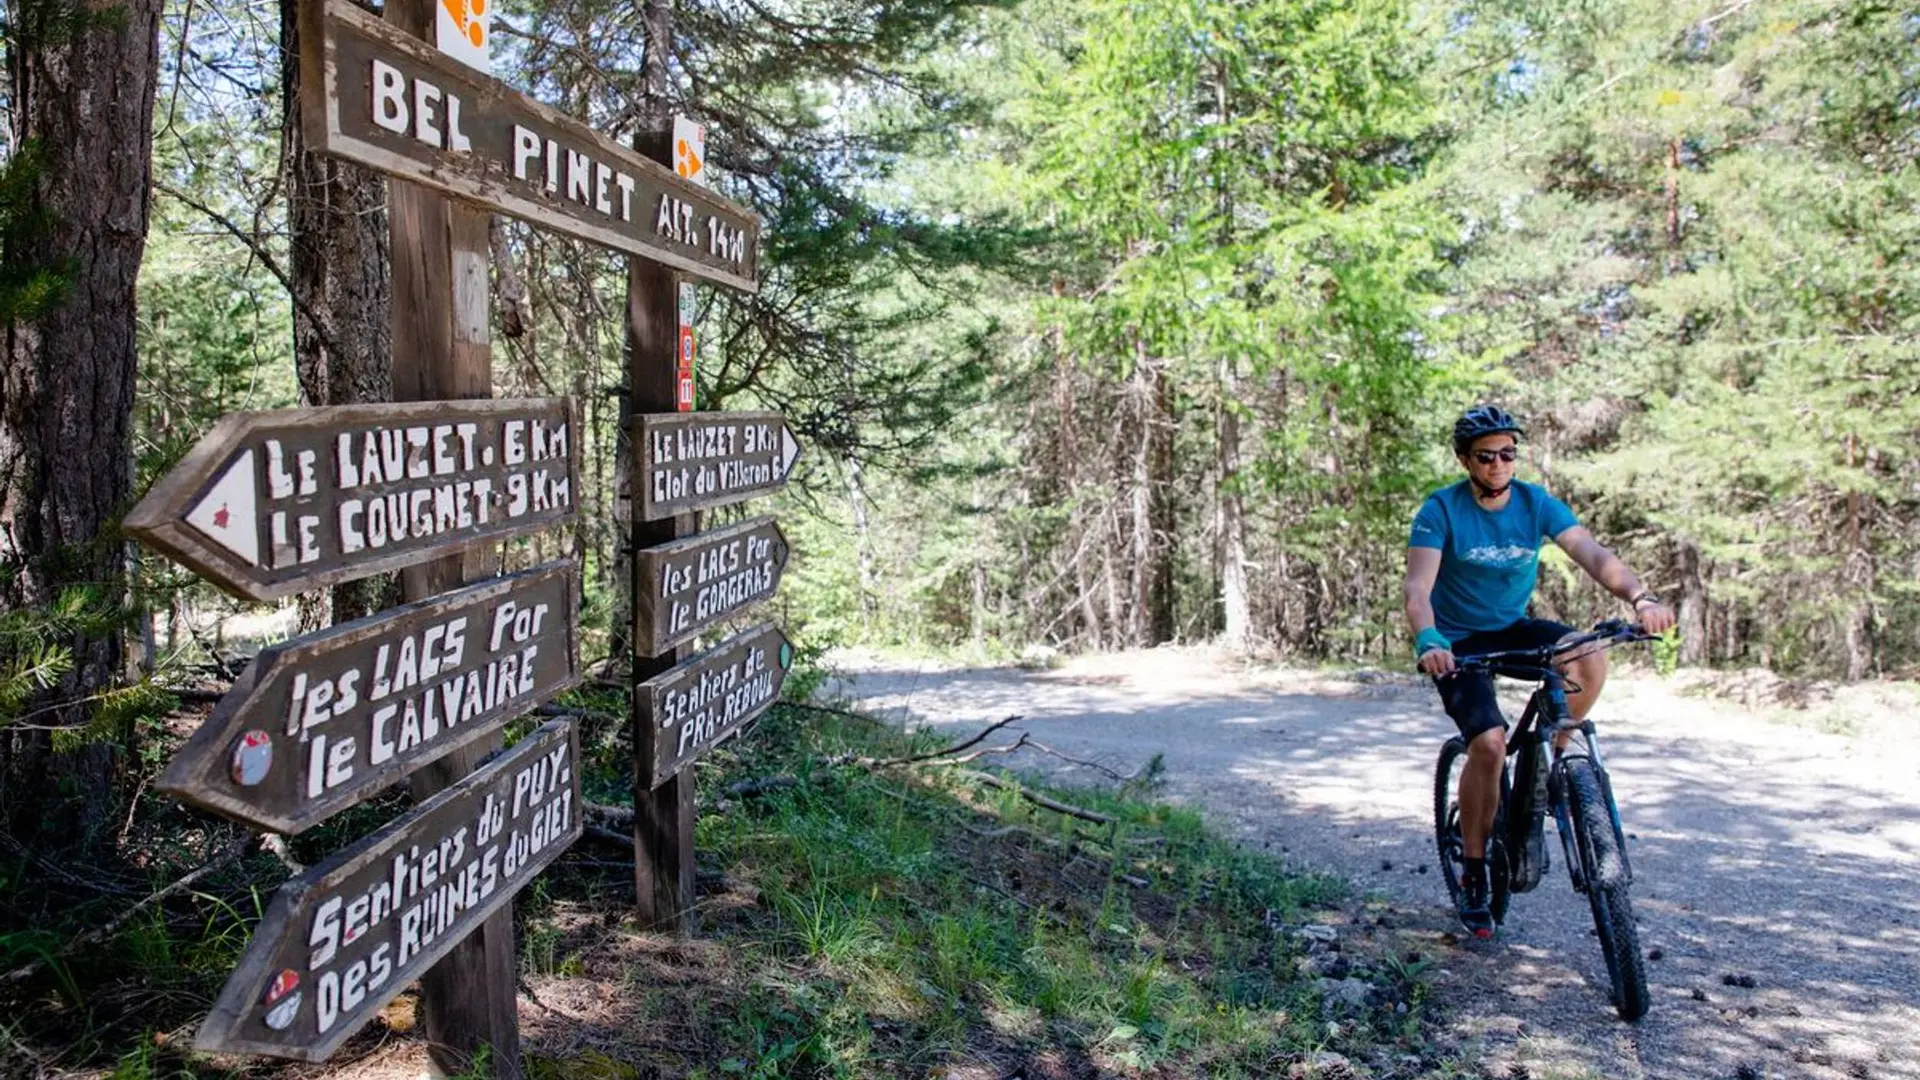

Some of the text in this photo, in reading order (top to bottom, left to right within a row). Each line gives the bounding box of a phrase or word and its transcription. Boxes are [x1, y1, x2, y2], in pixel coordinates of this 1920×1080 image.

[372, 59, 472, 153] BEL
[513, 124, 635, 222] PINET
[265, 439, 317, 498] LE
[653, 430, 673, 464] LE
[677, 426, 736, 461] LAUZET
[695, 465, 715, 494] du
[272, 511, 320, 569] LE
[698, 540, 740, 584] LACS
[696, 560, 772, 621] GORGERAS
[370, 617, 467, 700] LACS
[662, 646, 765, 728] Sentiers de
[370, 645, 537, 765] CALVAIRE
[309, 826, 467, 971] Sentiers
[476, 793, 505, 847] du
[398, 845, 499, 967] RUINES
